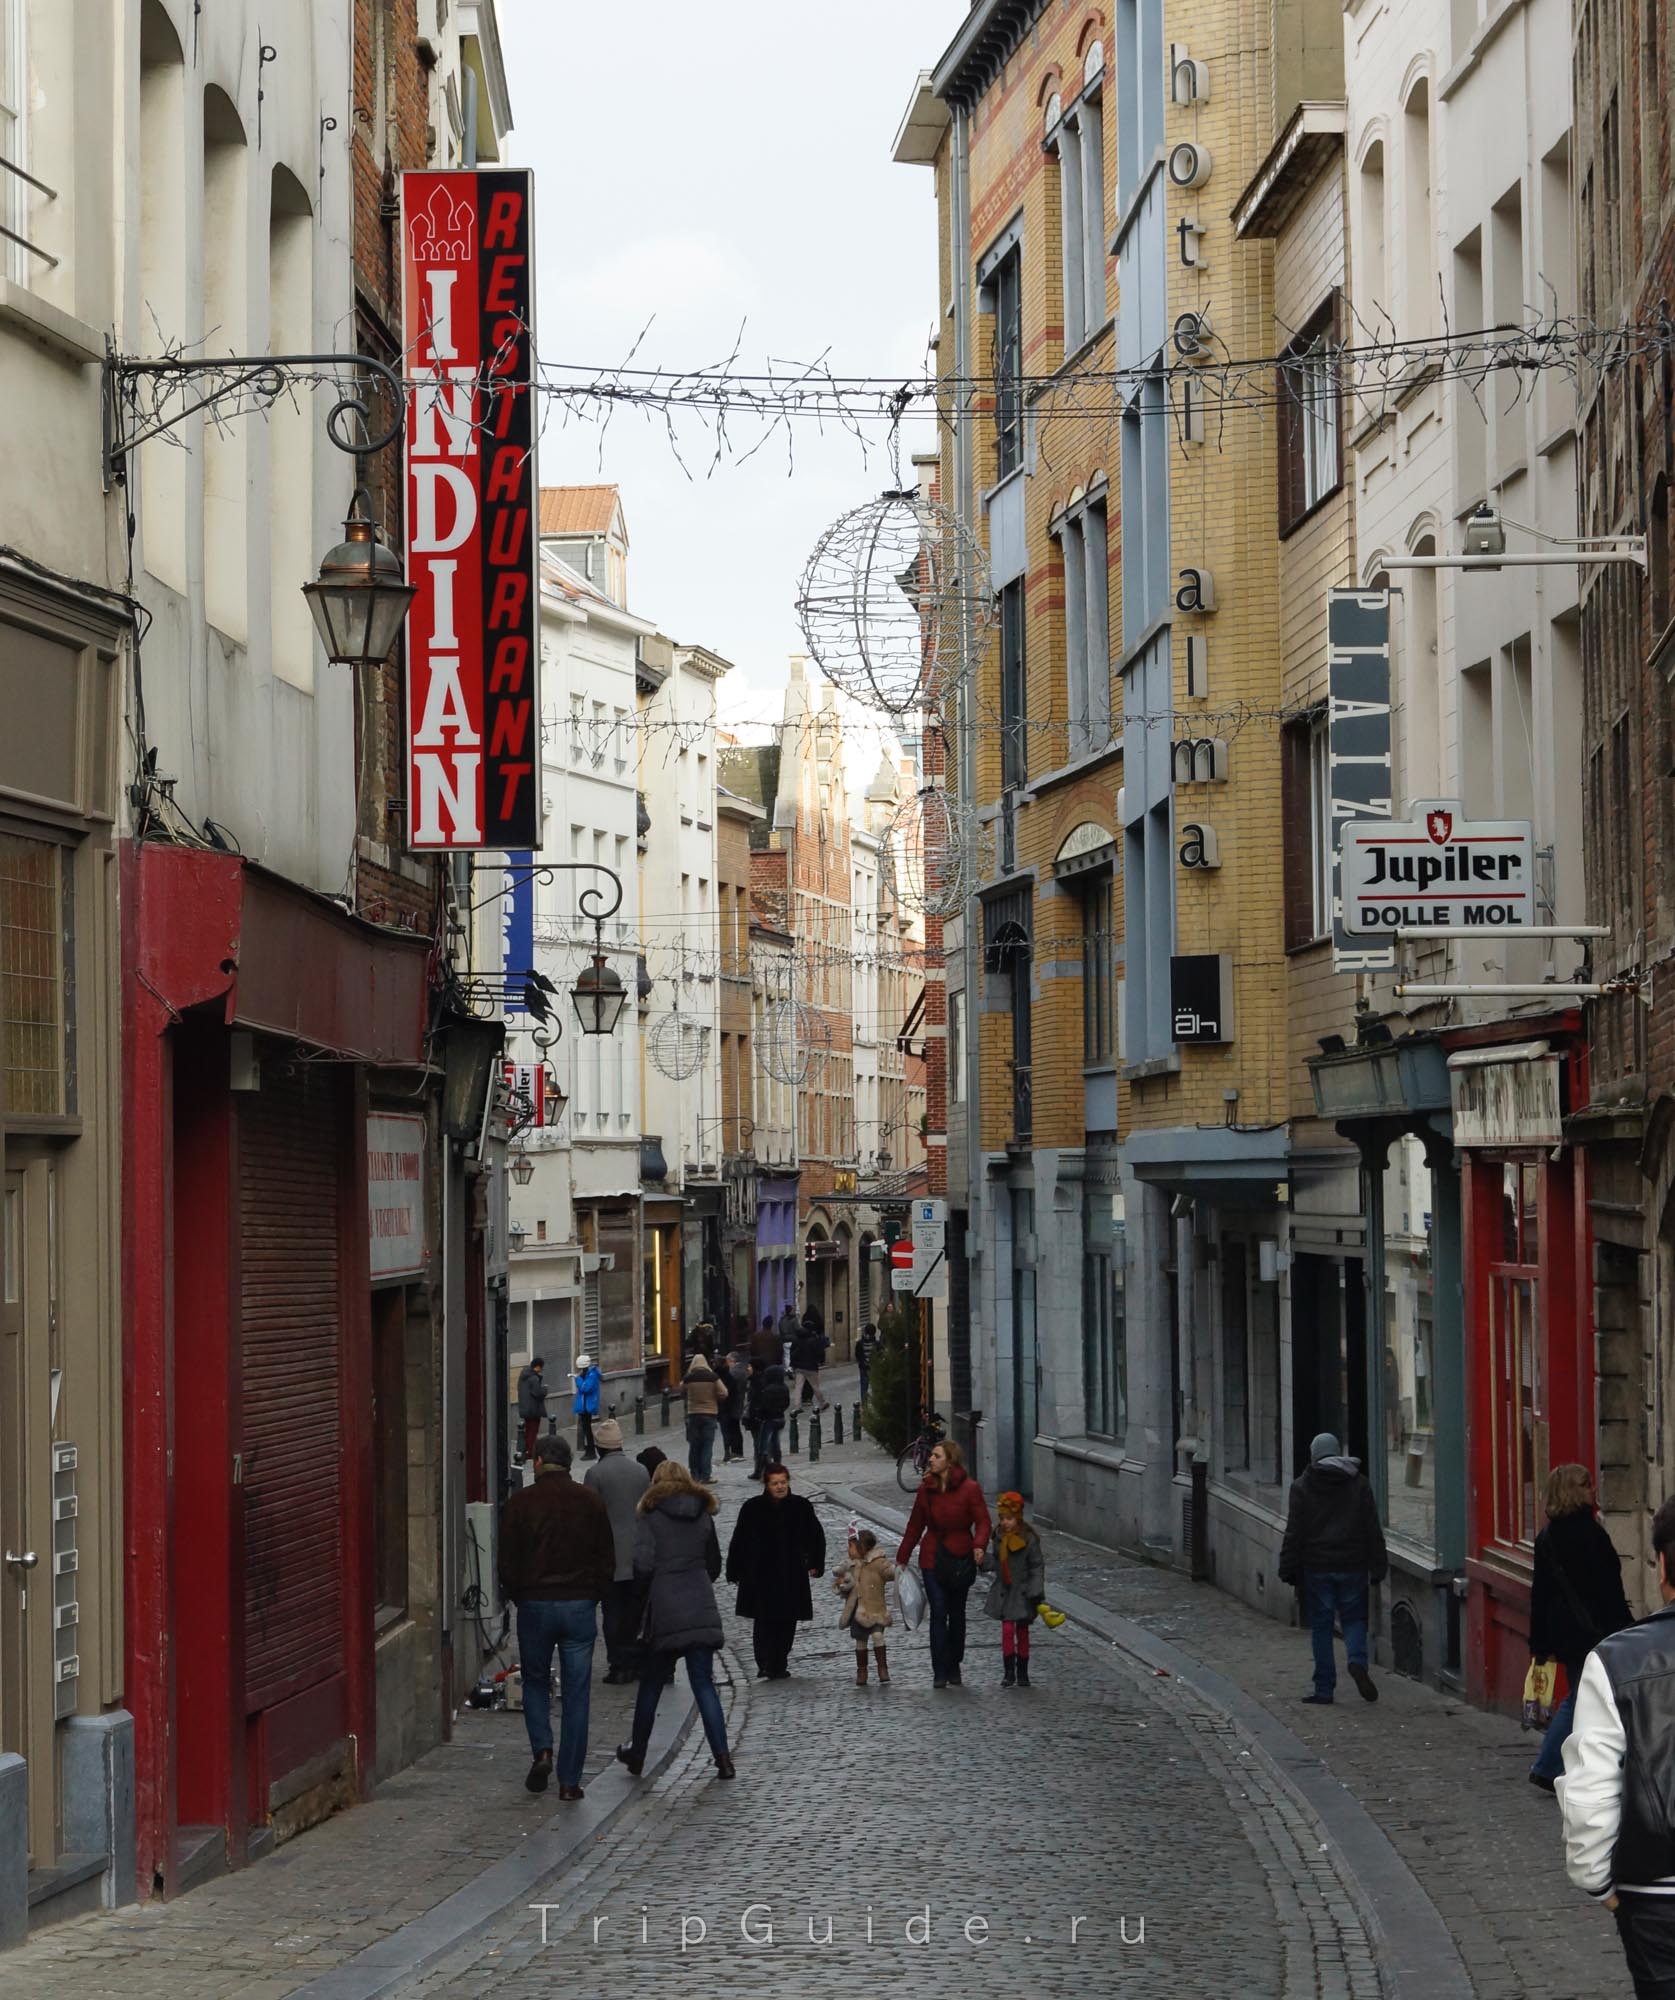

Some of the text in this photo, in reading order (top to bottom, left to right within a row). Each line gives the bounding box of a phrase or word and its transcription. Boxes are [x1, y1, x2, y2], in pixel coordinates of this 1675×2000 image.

[410, 270, 481, 843] INDIAN
[483, 191, 532, 821] RESTAURANT
[1169, 43, 1222, 869] hotel alma
[1328, 588, 1395, 974] PLAIZR
[1361, 846, 1522, 892] Jupiler
[1361, 905, 1522, 926] DOLLE MOL
